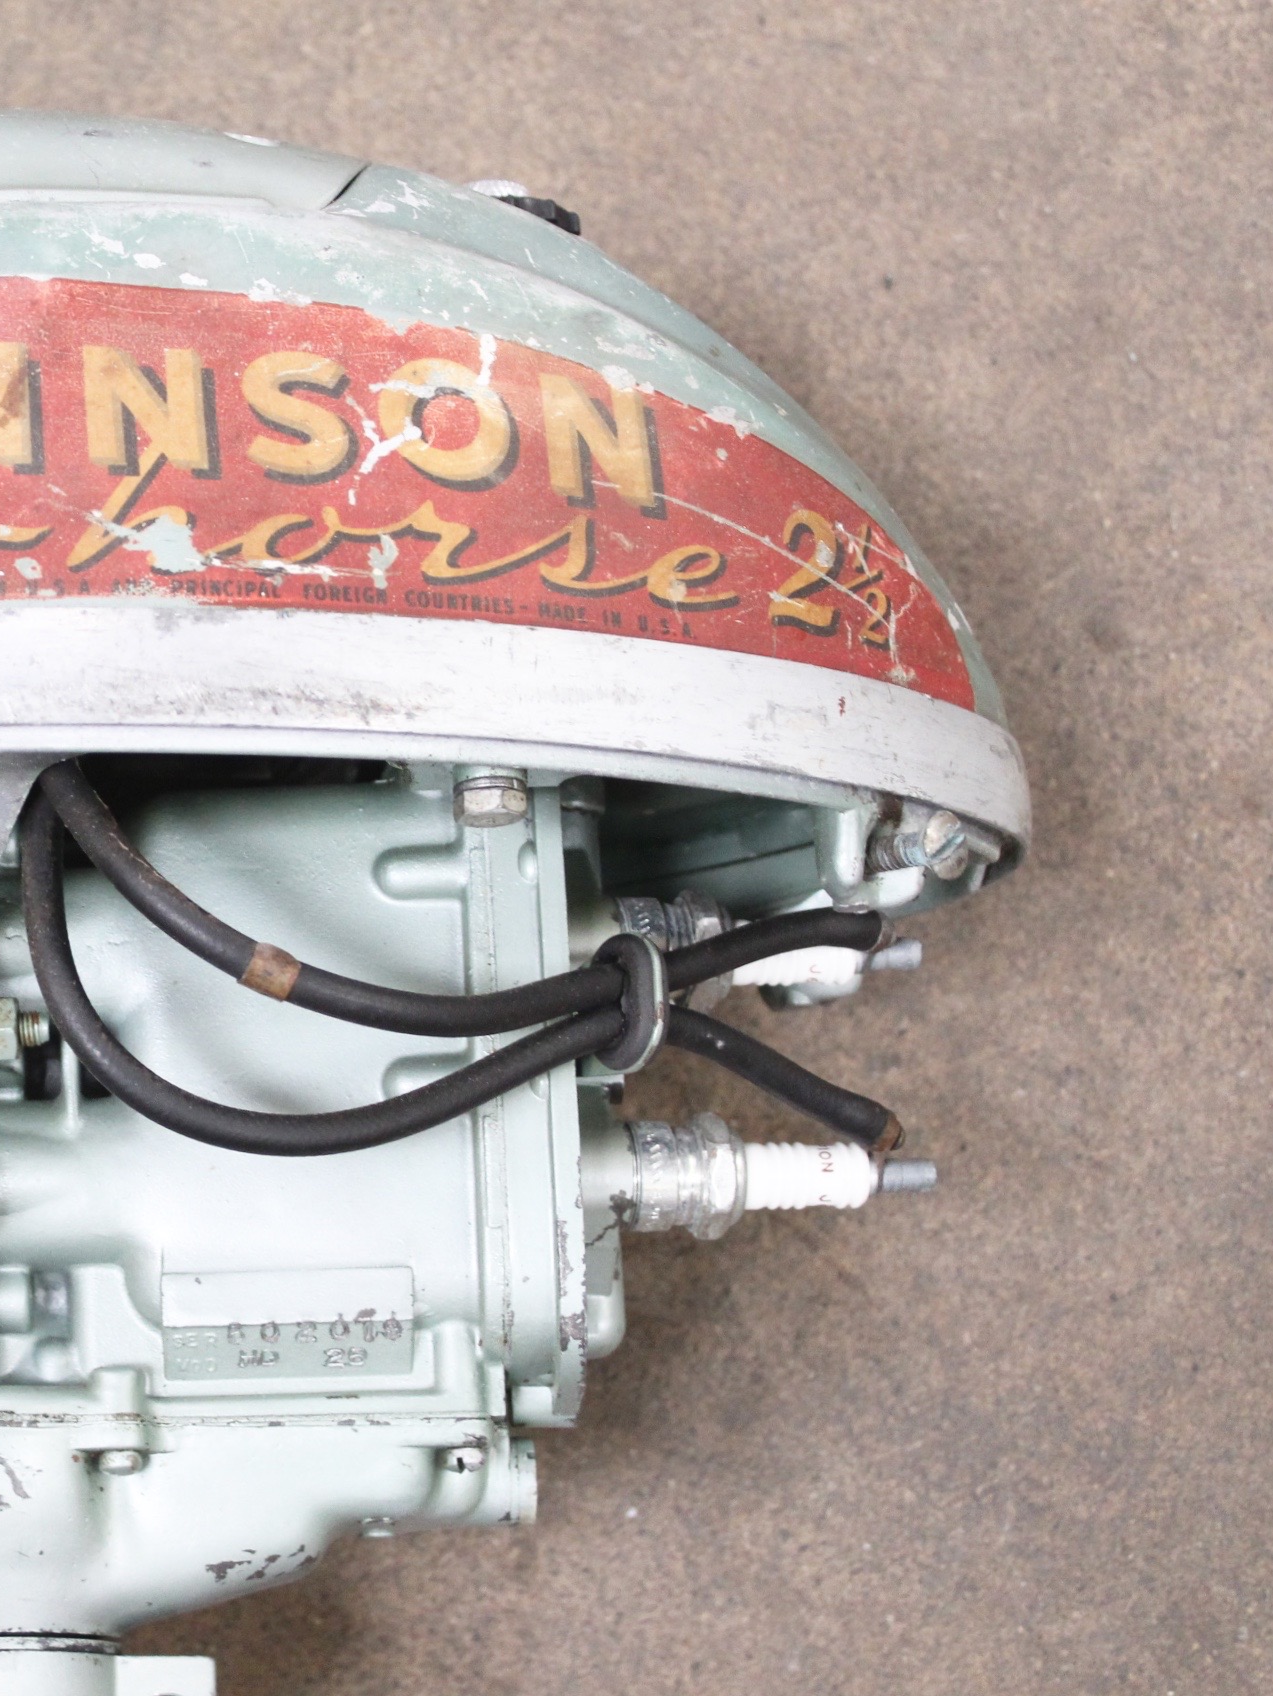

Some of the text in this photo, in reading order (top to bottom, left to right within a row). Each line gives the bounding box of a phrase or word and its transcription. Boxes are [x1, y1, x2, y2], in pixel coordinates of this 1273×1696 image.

[171, 578, 281, 598] PRINCIPAL
[302, 583, 389, 605] FOREIGN
[405, 589, 515, 615] COUNTRIES
[538, 602, 587, 622] MADE
[601, 609, 623, 628] IN
